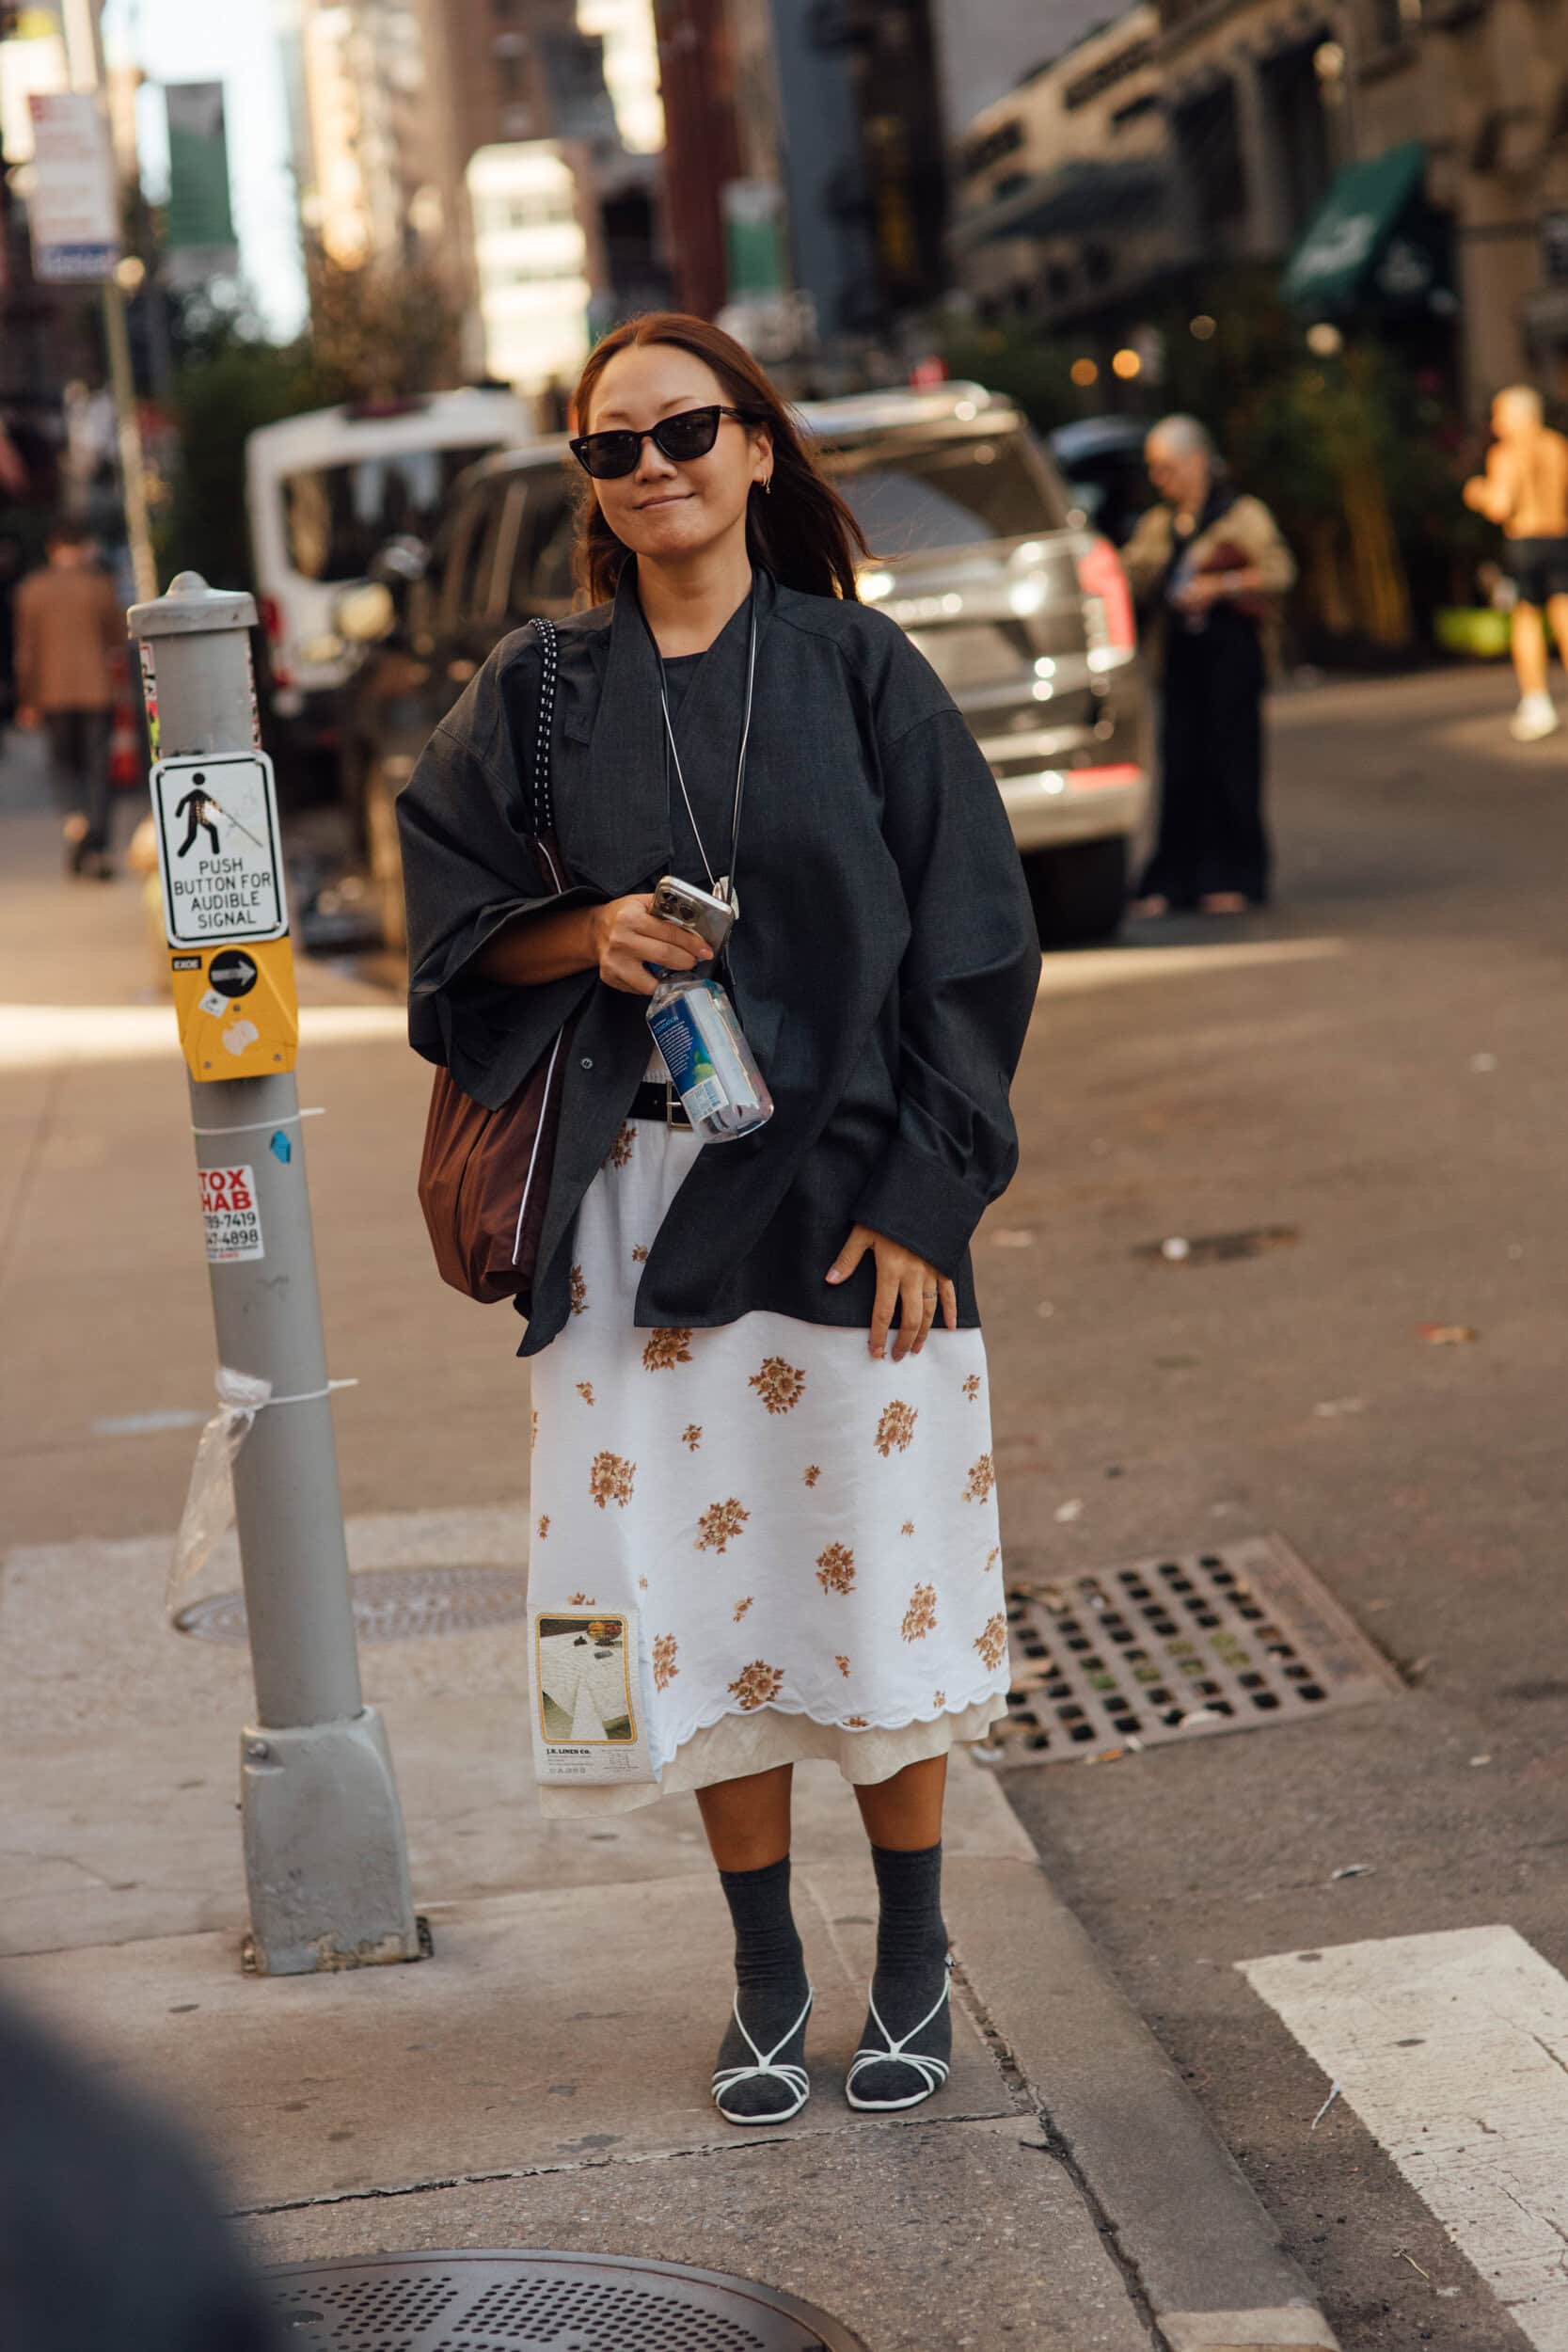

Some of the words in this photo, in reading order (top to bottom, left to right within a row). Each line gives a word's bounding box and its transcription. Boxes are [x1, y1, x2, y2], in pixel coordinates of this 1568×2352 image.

[198, 858, 244, 875] PUSH
[174, 876, 236, 896] BUTTON
[241, 872, 272, 889] FOR
[191, 890, 261, 912] AUDIBLE
[198, 910, 256, 930] SIGNAL
[198, 1168, 247, 1191] TOX
[200, 1190, 252, 1213] HAB
